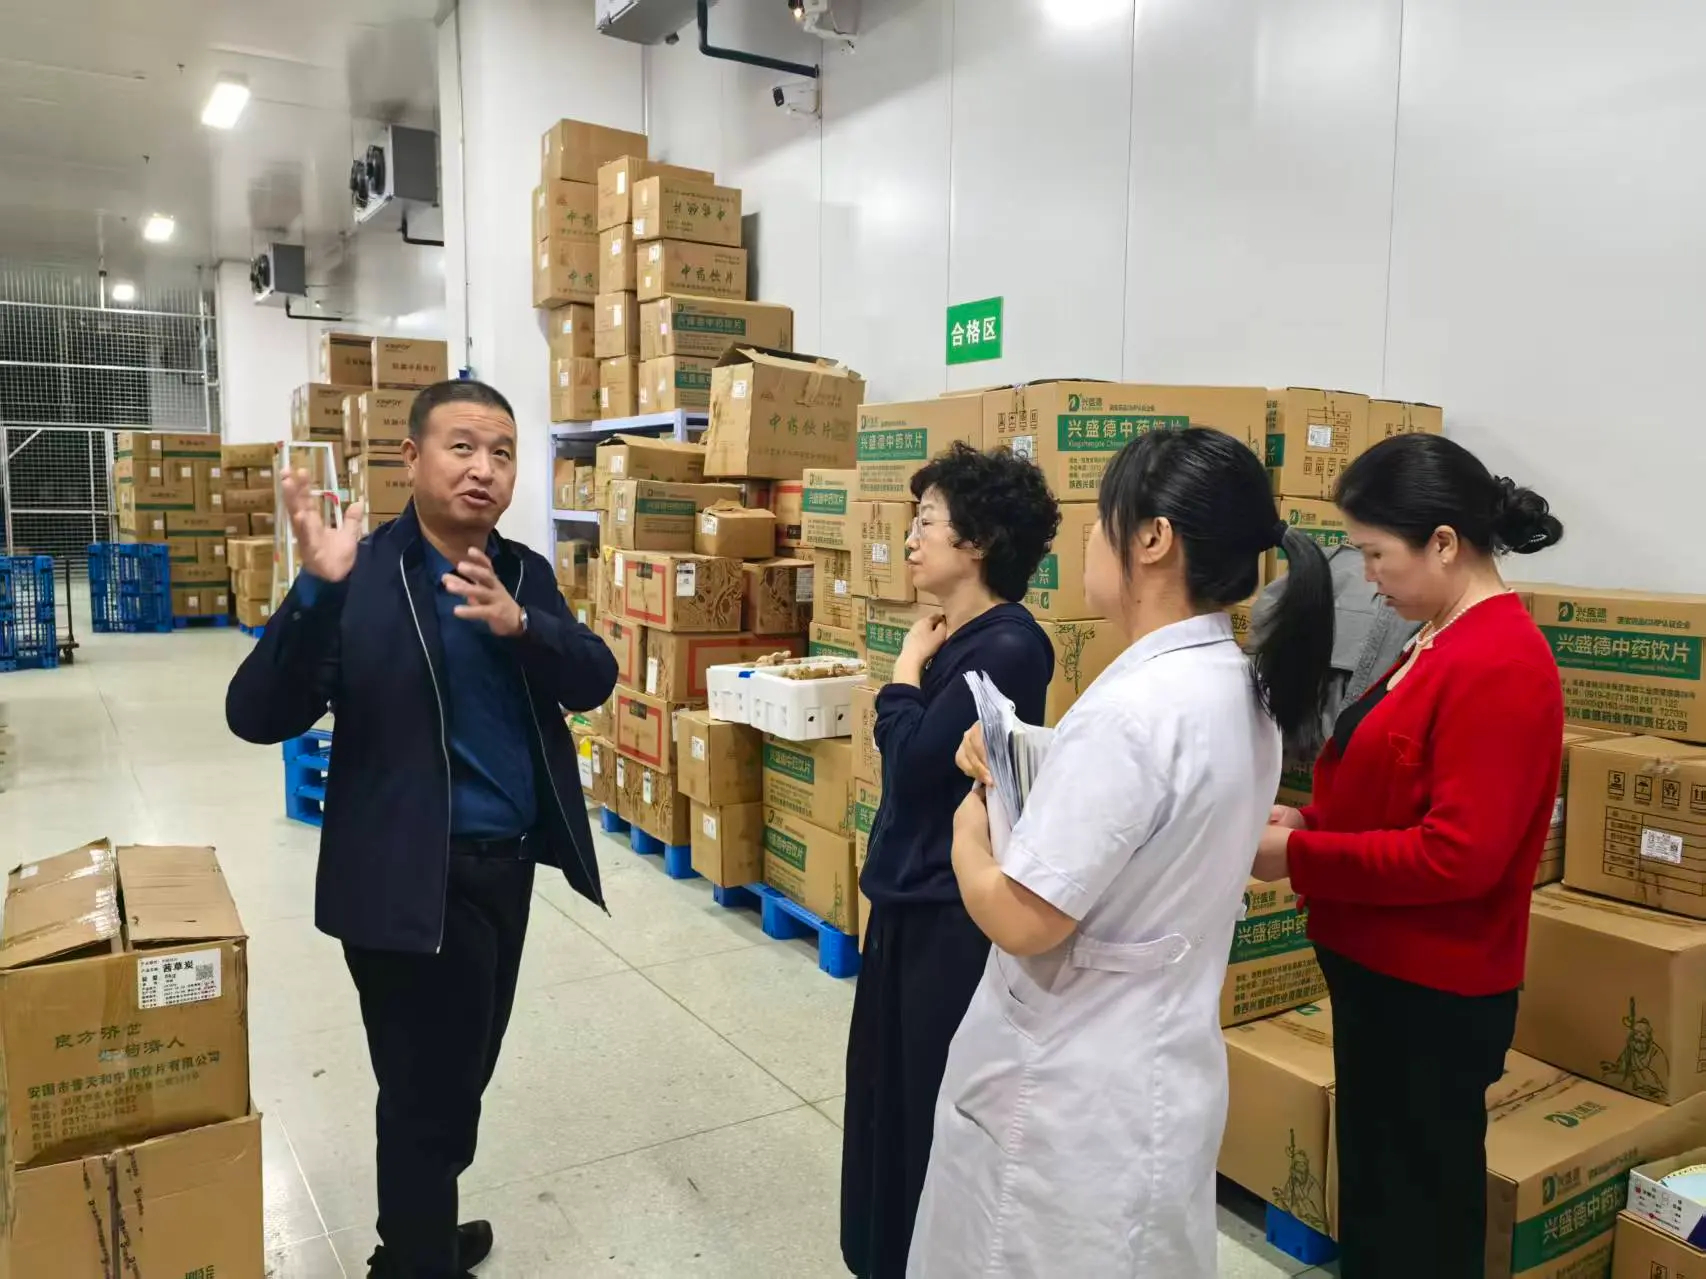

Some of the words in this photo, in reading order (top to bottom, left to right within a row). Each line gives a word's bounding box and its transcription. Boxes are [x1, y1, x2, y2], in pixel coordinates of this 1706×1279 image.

[951, 316, 997, 347] 合格区
[769, 412, 832, 437] 中药饮片
[860, 433, 923, 450] 兴盛德中药饮片
[1556, 633, 1691, 664] 兴盛德中药饮片
